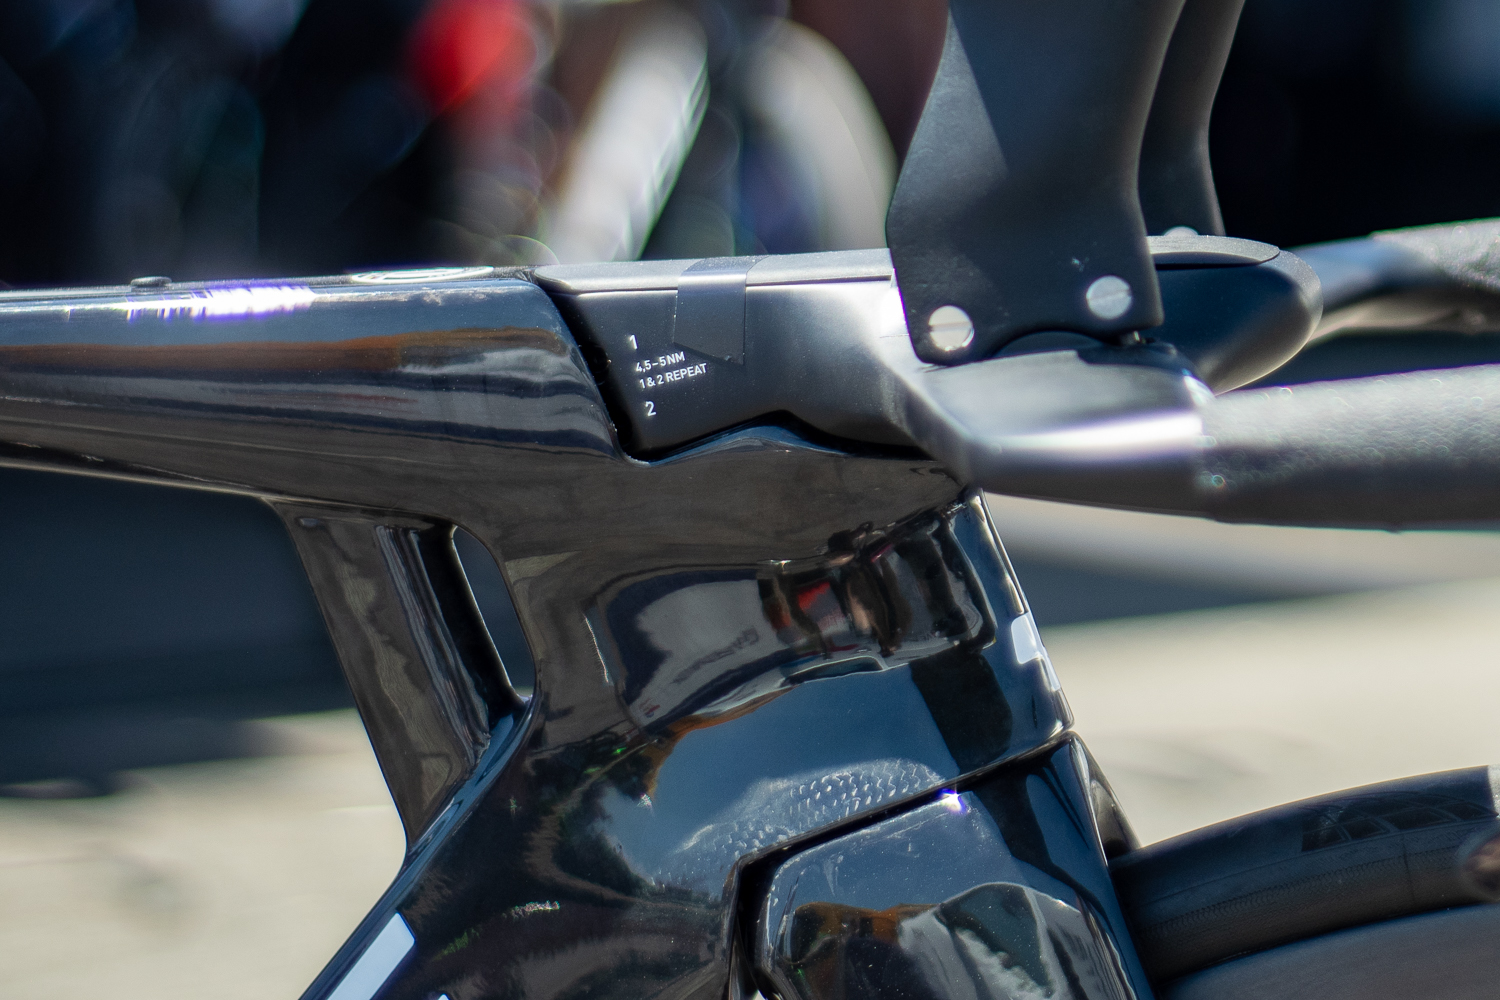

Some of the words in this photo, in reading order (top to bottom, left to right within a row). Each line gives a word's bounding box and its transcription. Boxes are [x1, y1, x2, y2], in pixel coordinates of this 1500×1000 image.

[629, 334, 638, 350] 1
[639, 378, 646, 389] 1
[647, 376, 656, 388] &
[657, 374, 665, 385] 2
[665, 363, 707, 383] REPEAT
[645, 401, 657, 417] 2
